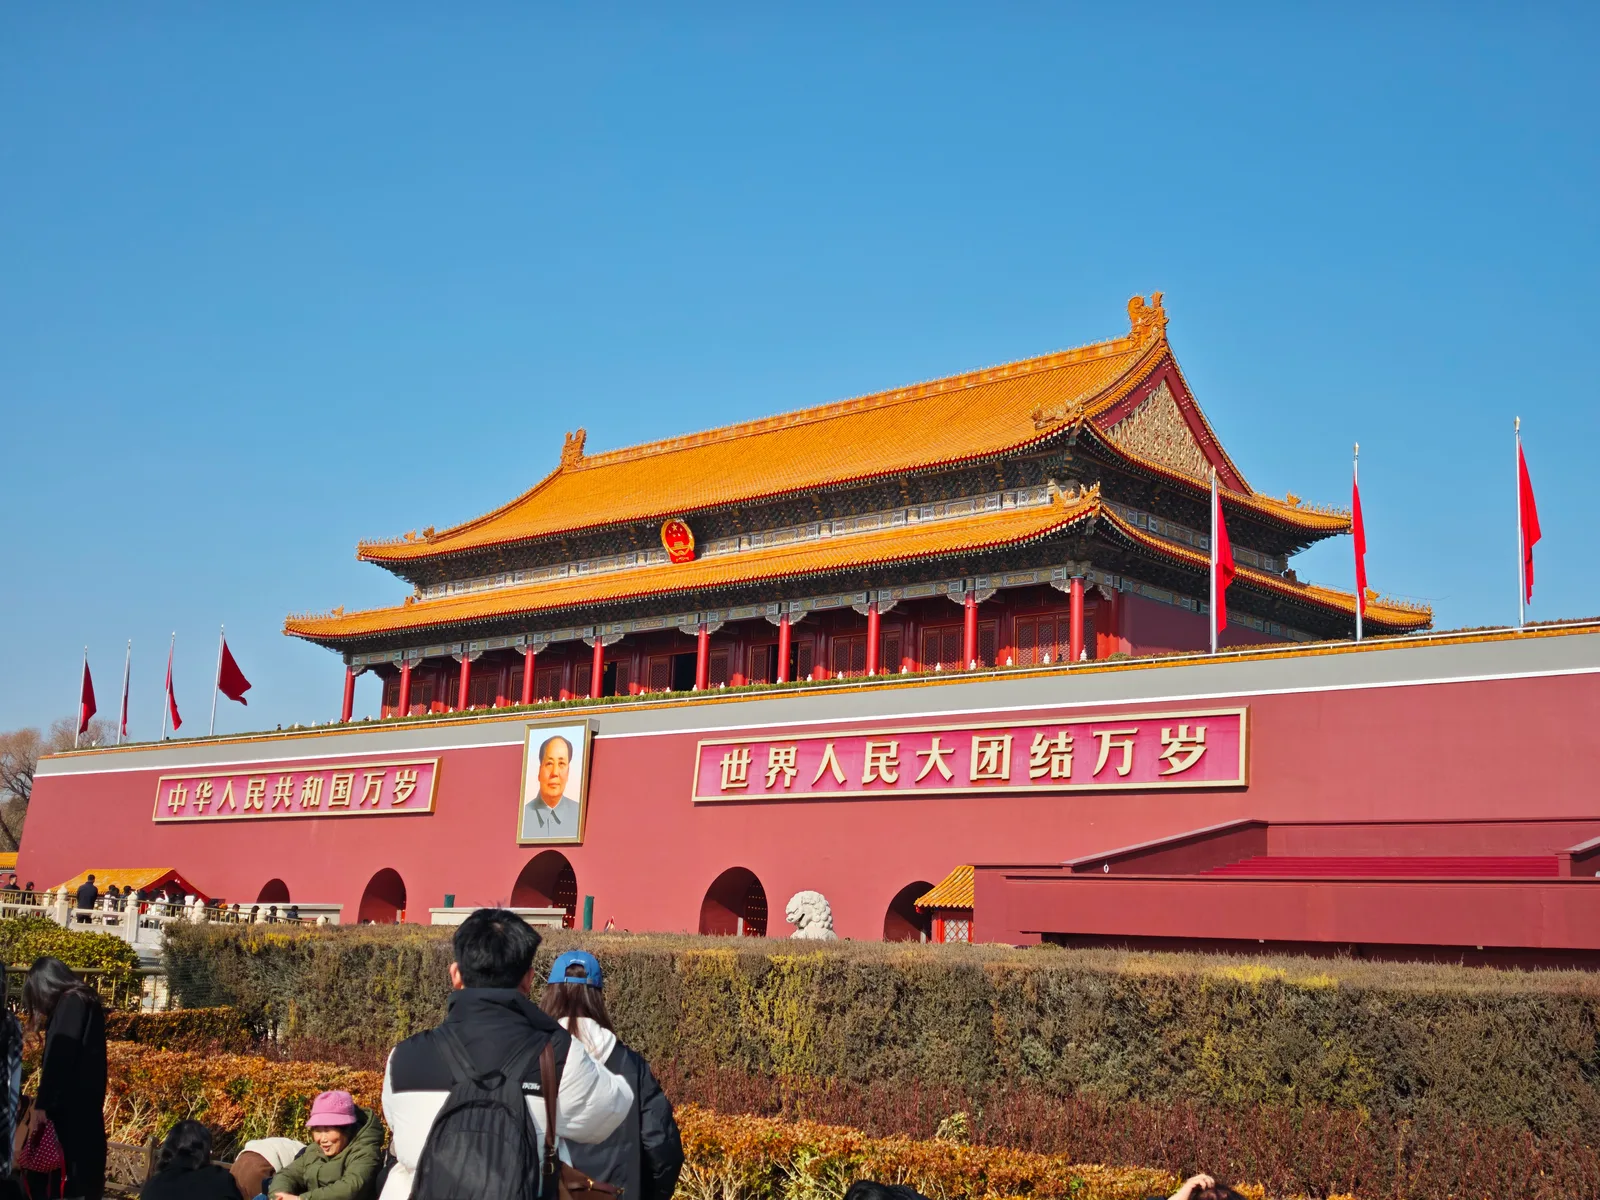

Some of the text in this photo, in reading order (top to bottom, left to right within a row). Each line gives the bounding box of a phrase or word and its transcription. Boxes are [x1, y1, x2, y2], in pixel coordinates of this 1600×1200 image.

[719, 725, 1207, 790] 世界人民大团结万岁
[167, 769, 418, 813] 中华人民共和国万岁
